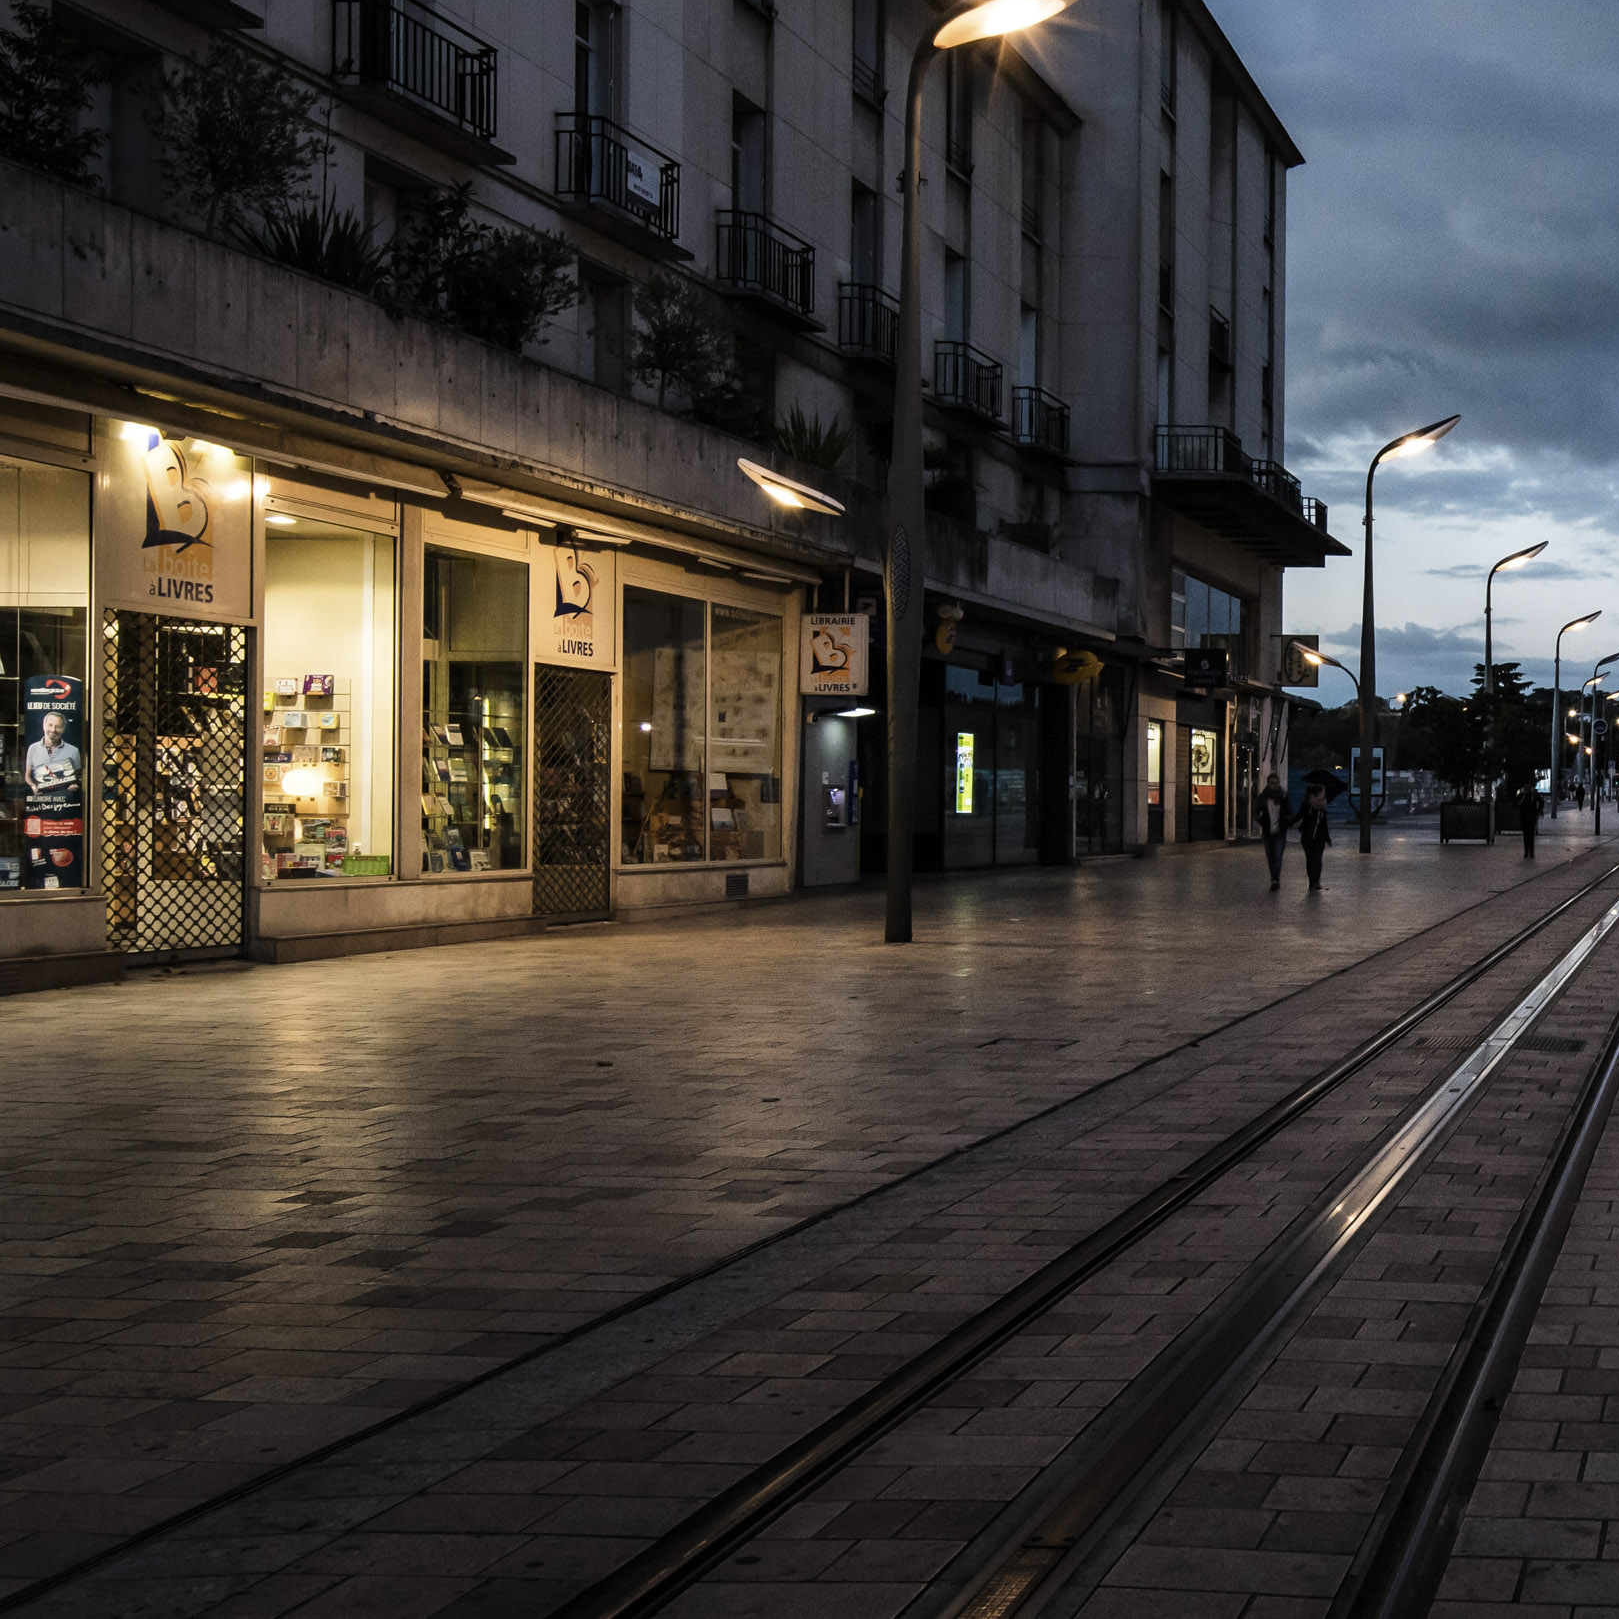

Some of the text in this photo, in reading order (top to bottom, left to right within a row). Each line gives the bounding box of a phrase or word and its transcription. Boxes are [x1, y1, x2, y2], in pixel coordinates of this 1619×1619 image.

[149, 577, 215, 604] à LIVRES
[811, 617, 856, 626] LIBRAIRIE
[562, 638, 594, 657] LIVRES
[818, 683, 851, 692] LIVRES
[43, 702, 51, 710] DE
[51, 700, 77, 711] SOCIÉTÉ
